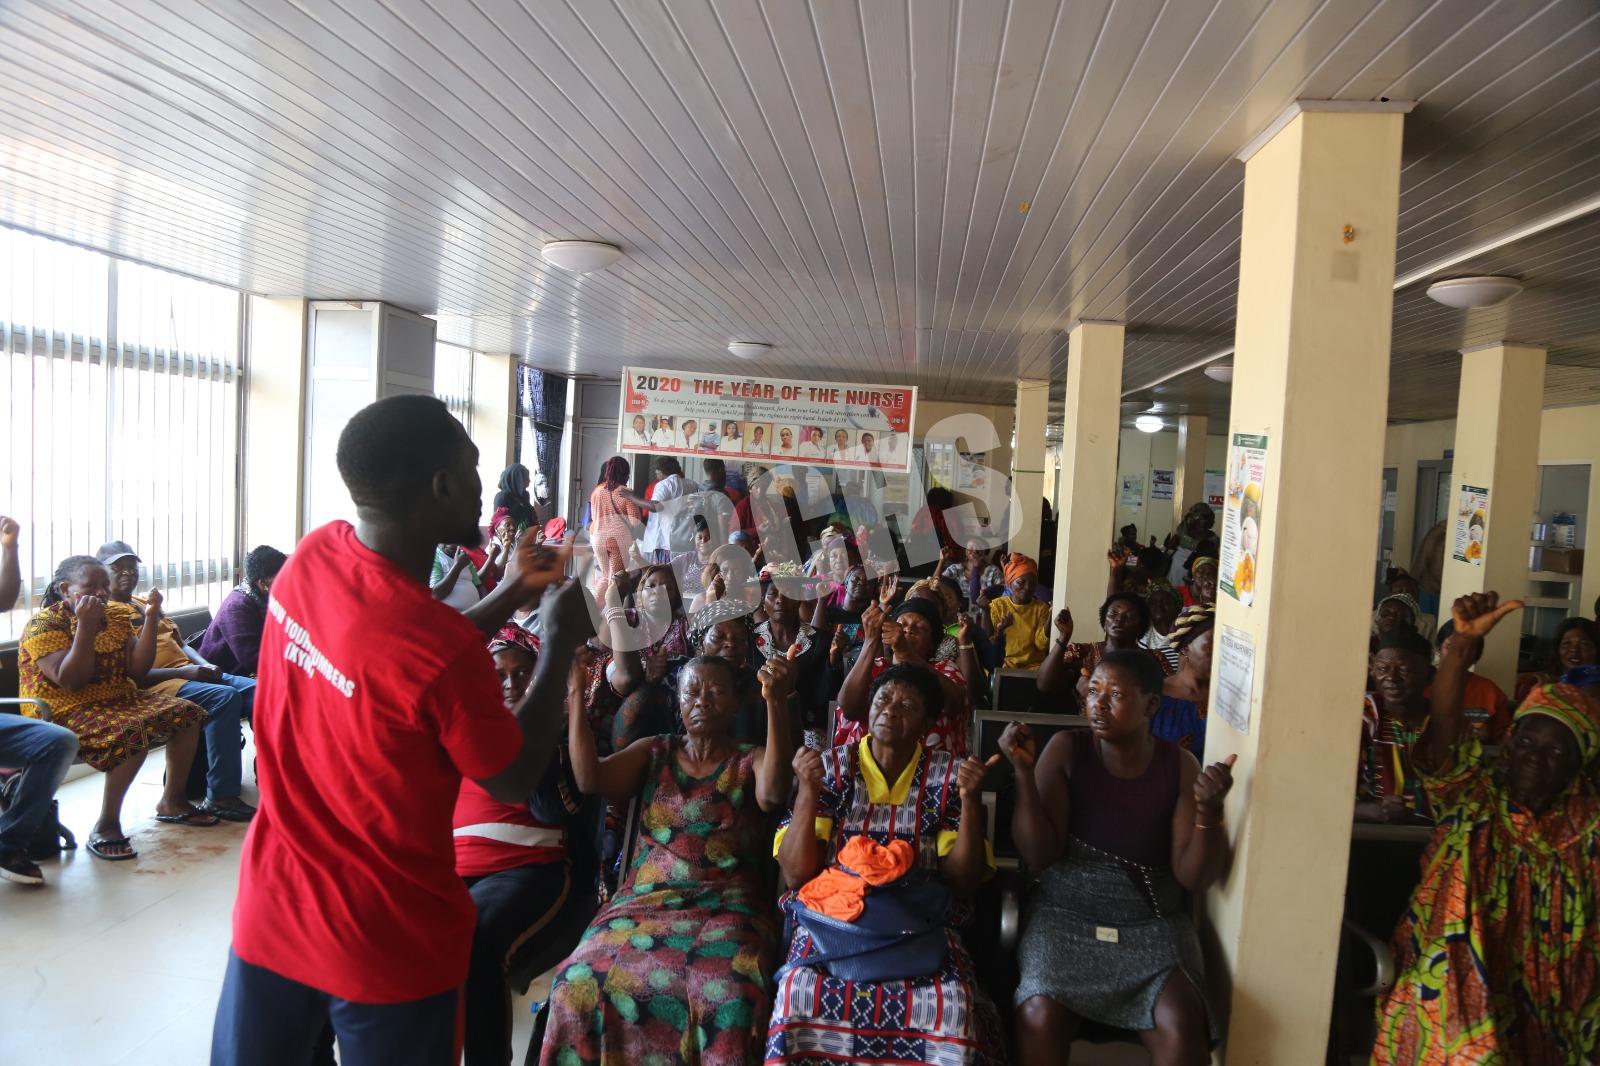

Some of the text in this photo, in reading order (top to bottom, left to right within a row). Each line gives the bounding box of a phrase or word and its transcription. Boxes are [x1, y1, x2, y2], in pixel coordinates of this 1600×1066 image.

[636, 375, 904, 409] 2020 THE YEAR OF THE NURSE
[310, 645, 356, 698] UMBERS
